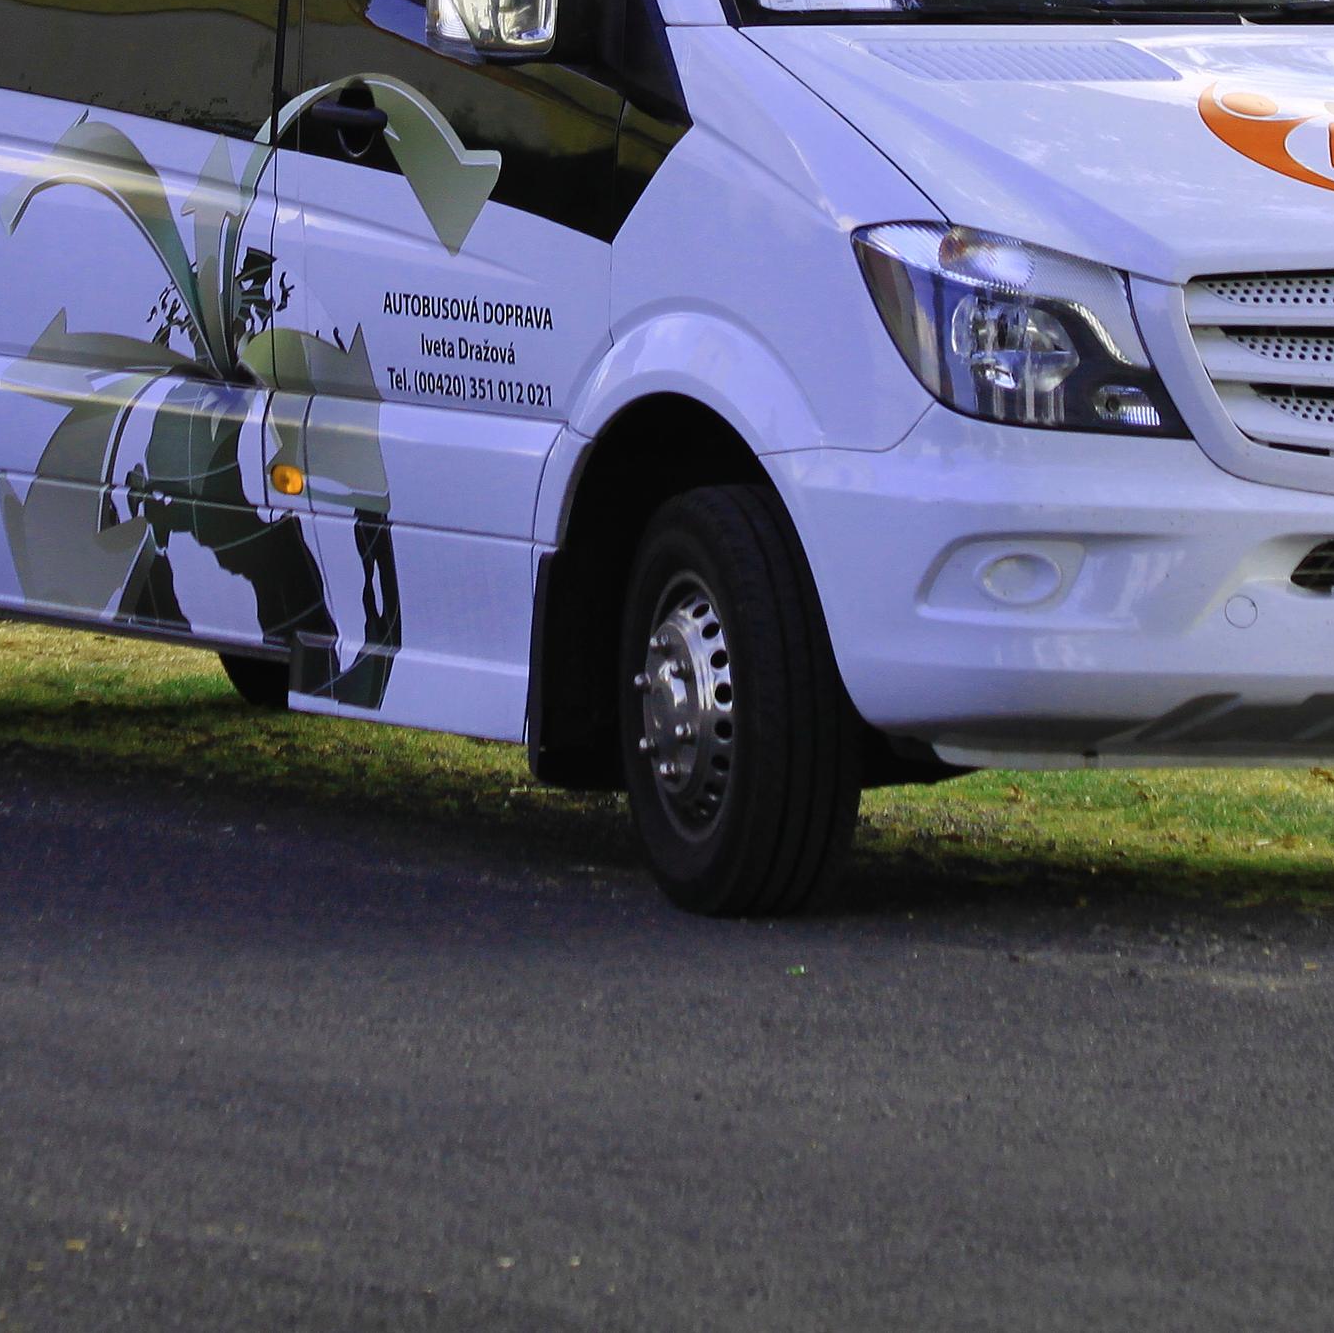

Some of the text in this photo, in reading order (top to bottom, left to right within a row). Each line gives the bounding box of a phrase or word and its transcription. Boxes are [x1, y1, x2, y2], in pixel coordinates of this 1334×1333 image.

[383, 292, 553, 330] AUTOBUSOVÁ DOPRAVA
[420, 333, 515, 365] Iveta Dražová
[387, 367, 553, 408] Tel. (00420) 351 012 021
